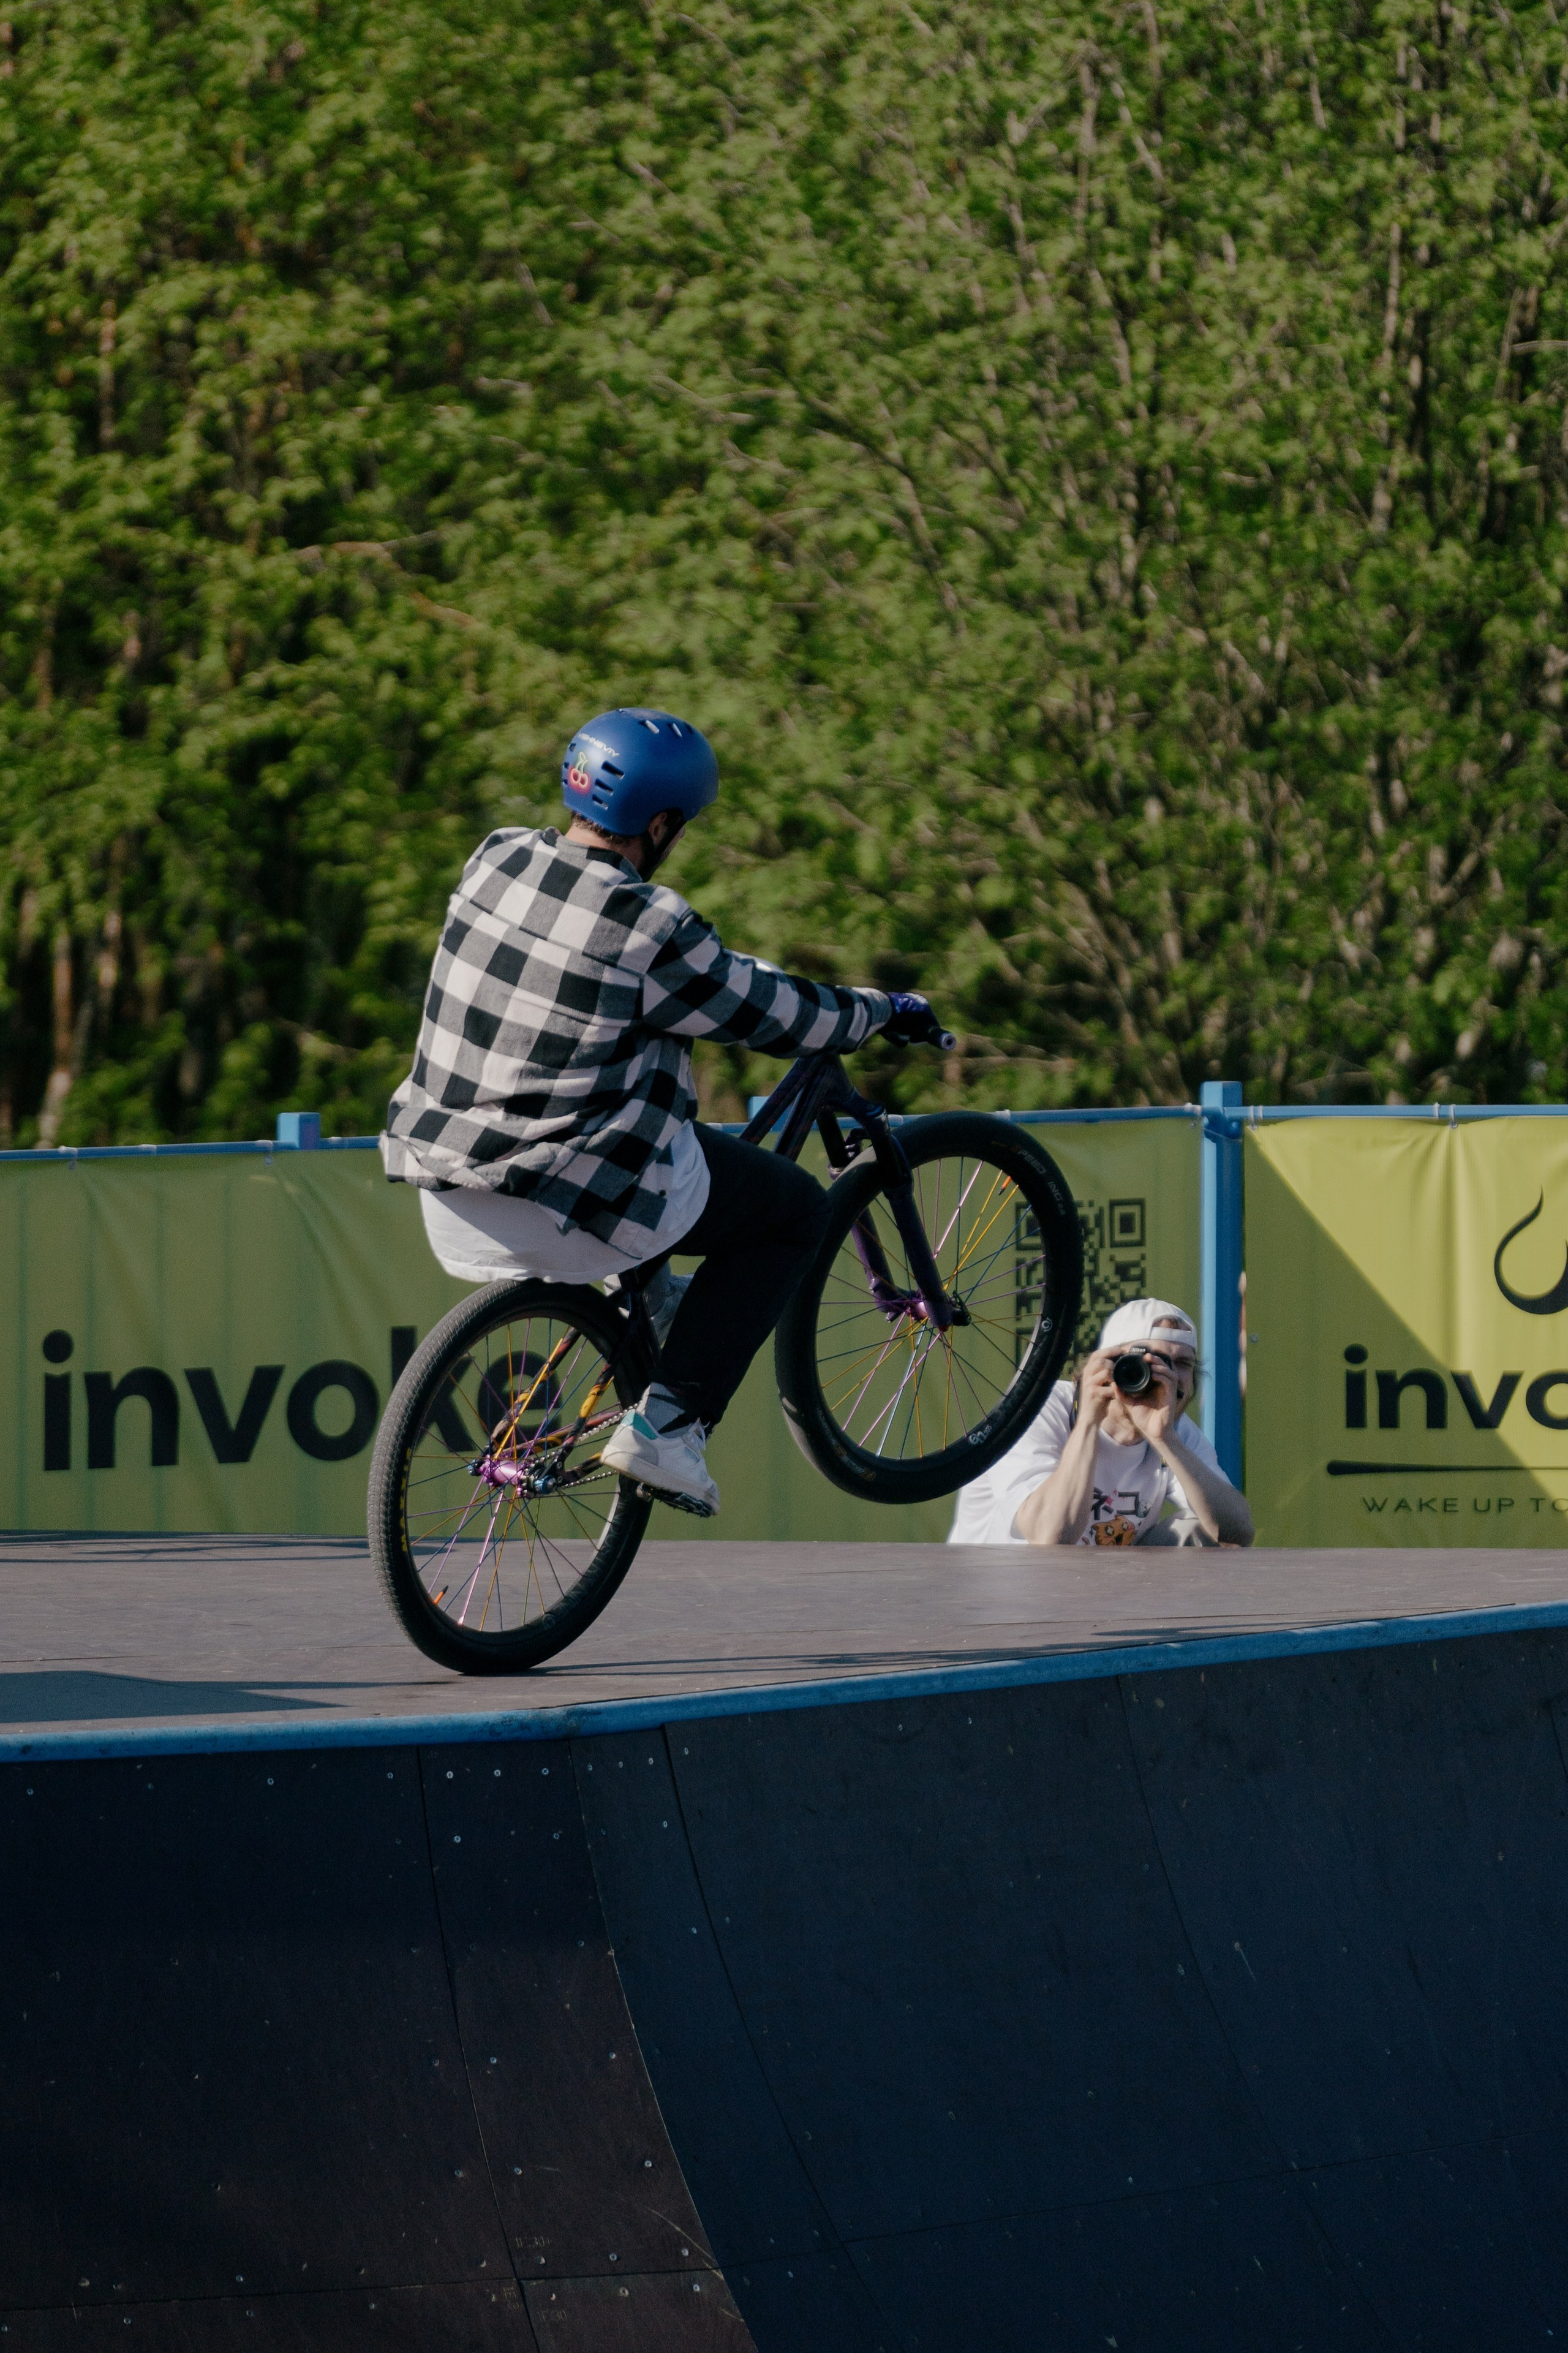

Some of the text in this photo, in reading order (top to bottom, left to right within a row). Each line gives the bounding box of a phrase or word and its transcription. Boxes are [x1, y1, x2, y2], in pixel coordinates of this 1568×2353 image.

[1362, 1497, 1568, 1513] WAKE UP TO
